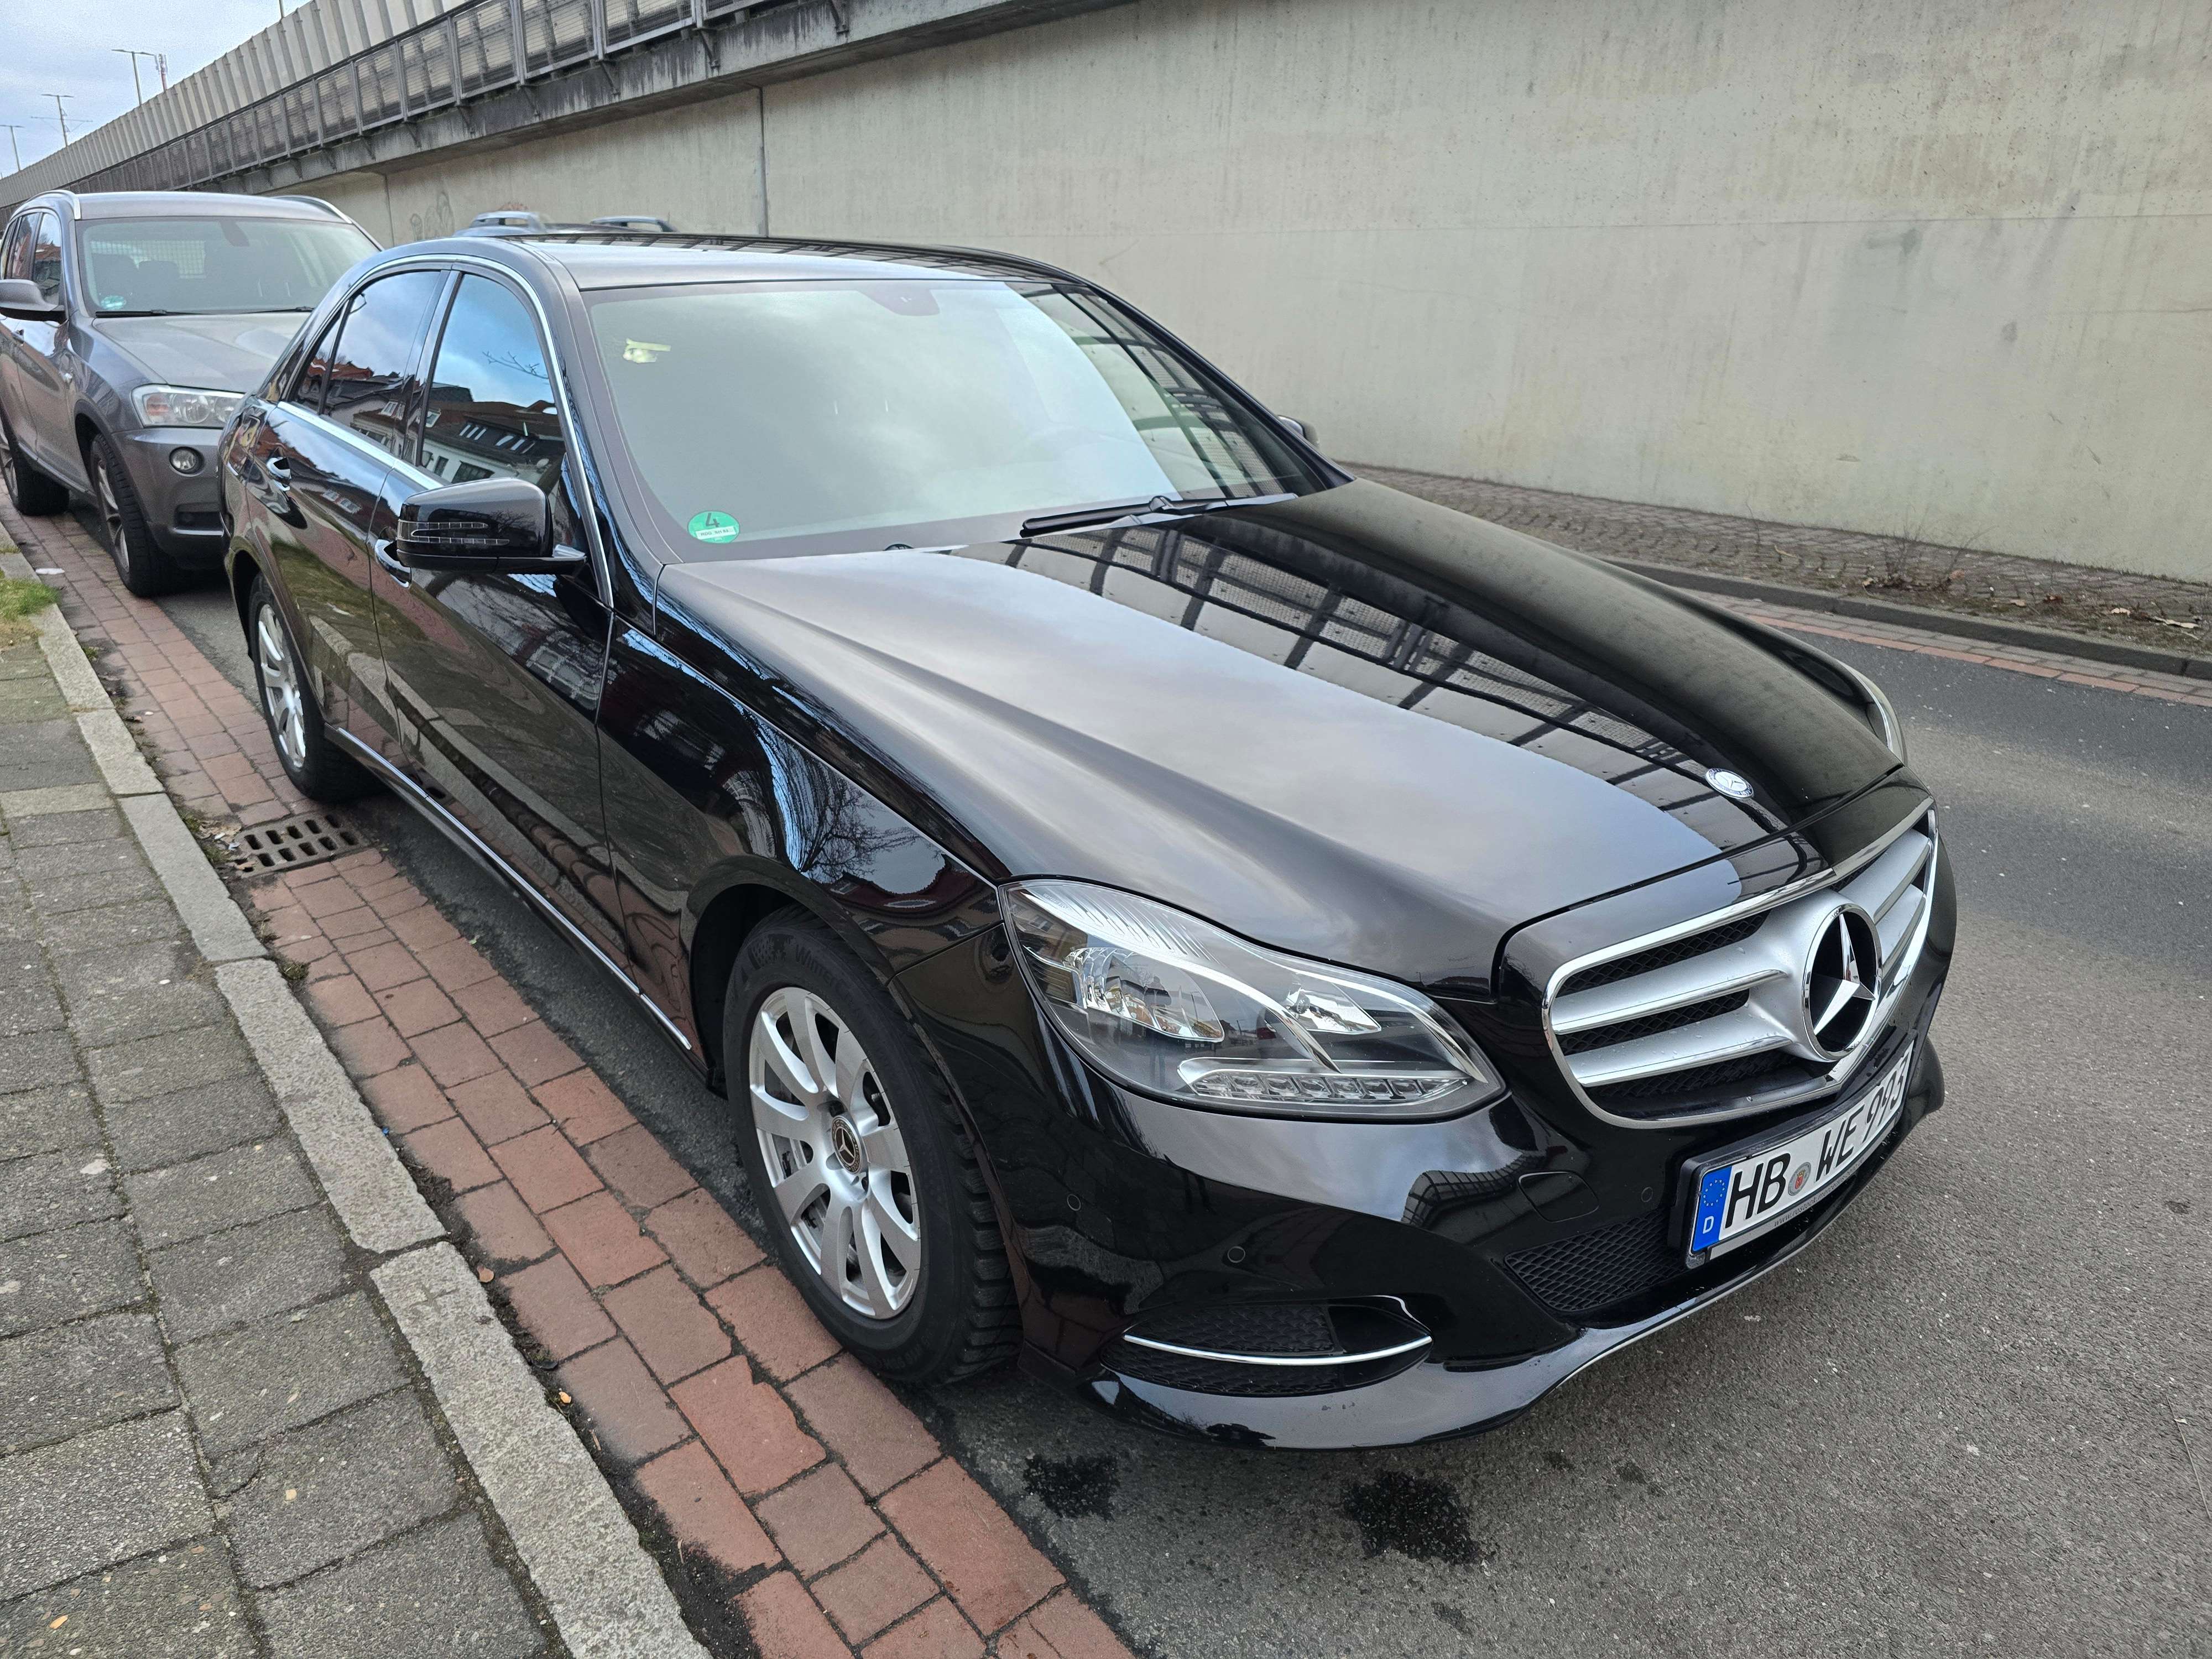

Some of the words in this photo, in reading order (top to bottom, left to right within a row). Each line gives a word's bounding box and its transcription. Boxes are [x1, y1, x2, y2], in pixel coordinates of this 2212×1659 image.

[706, 513, 721, 528] 4
[1724, 1153, 1791, 1229] HB
[1815, 1104, 1863, 1182] WE
[1862, 1052, 1910, 1143] 993
[1702, 1215, 1714, 1234] D
